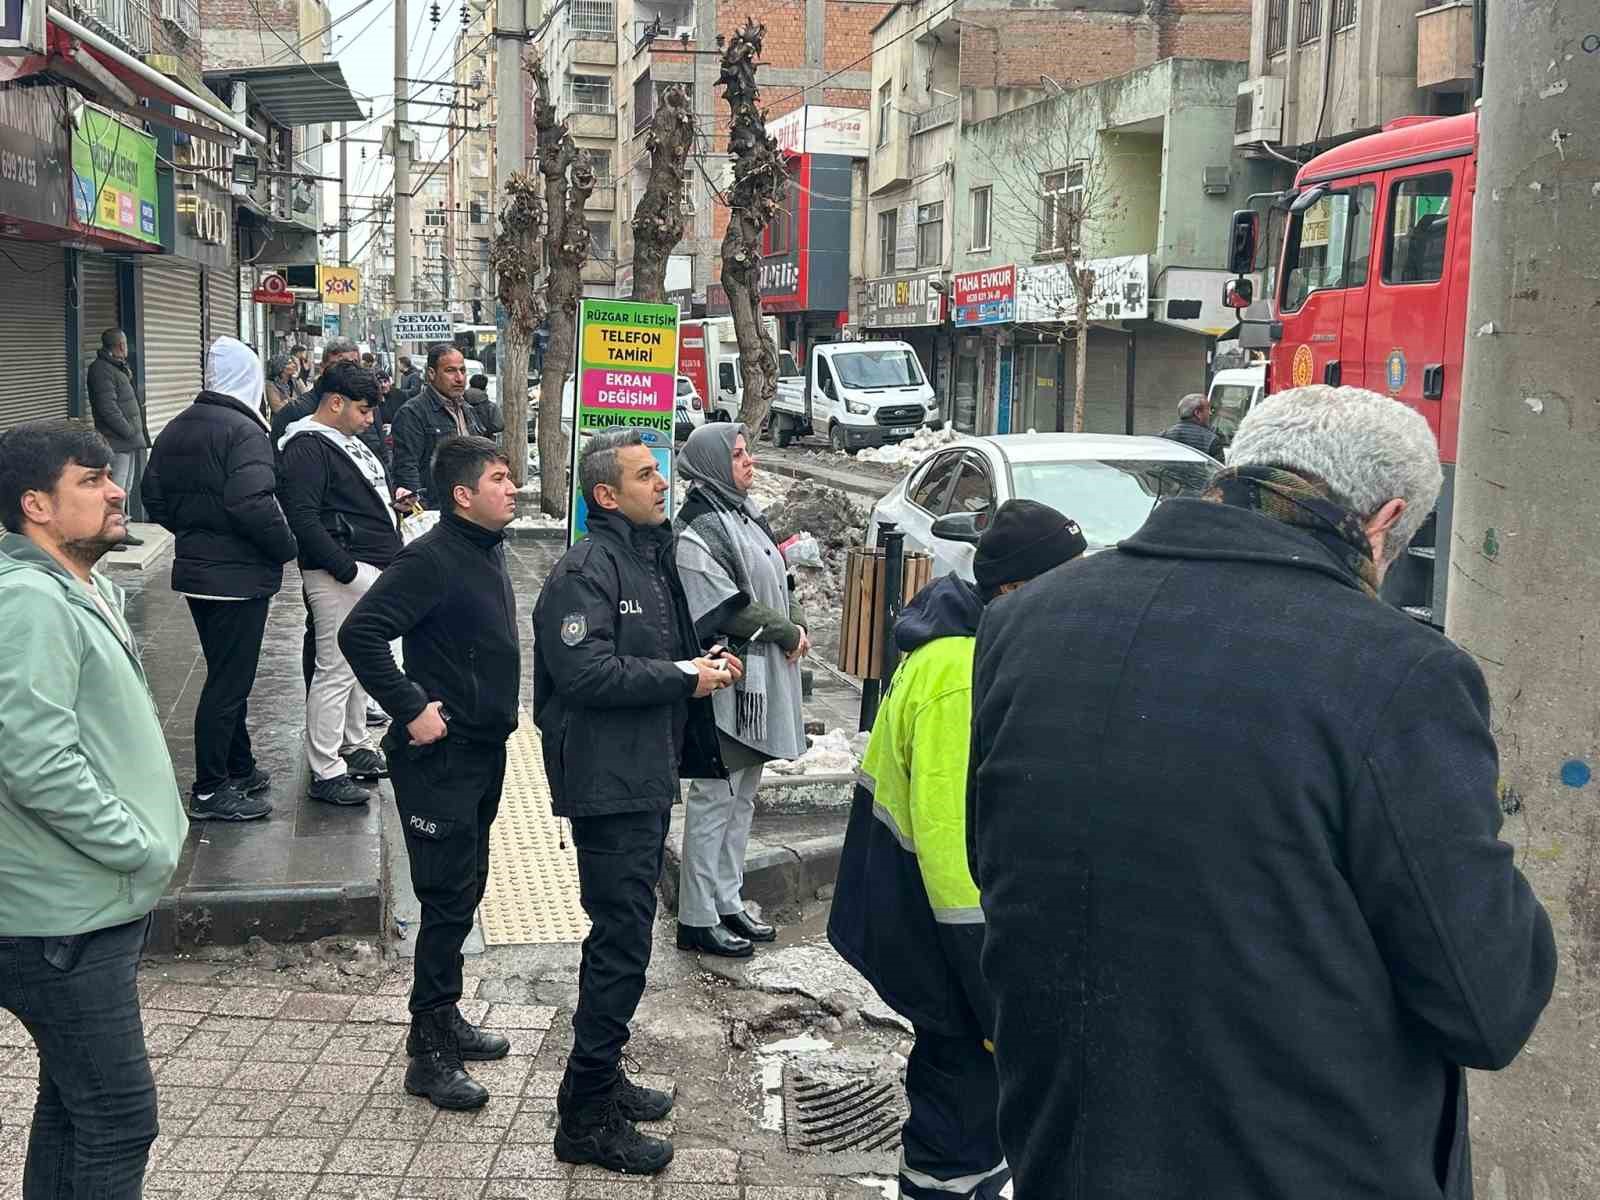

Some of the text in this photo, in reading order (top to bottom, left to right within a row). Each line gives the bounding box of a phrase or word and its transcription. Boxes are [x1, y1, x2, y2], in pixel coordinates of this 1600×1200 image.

[957, 275, 979, 293] TAHA
[981, 269, 1012, 289] EVKUR
[398, 315, 447, 324] SEVAL
[587, 309, 677, 327] RÜZGAR İLETİŞİM
[394, 323, 450, 333] TELEKOM
[601, 329, 661, 345] TELEFON
[607, 347, 653, 363] TAMİRİ
[606, 373, 652, 388] EKRAN
[598, 388, 658, 406] DEĞİŞİMİ
[582, 412, 671, 431] TEKNİK SERVİS
